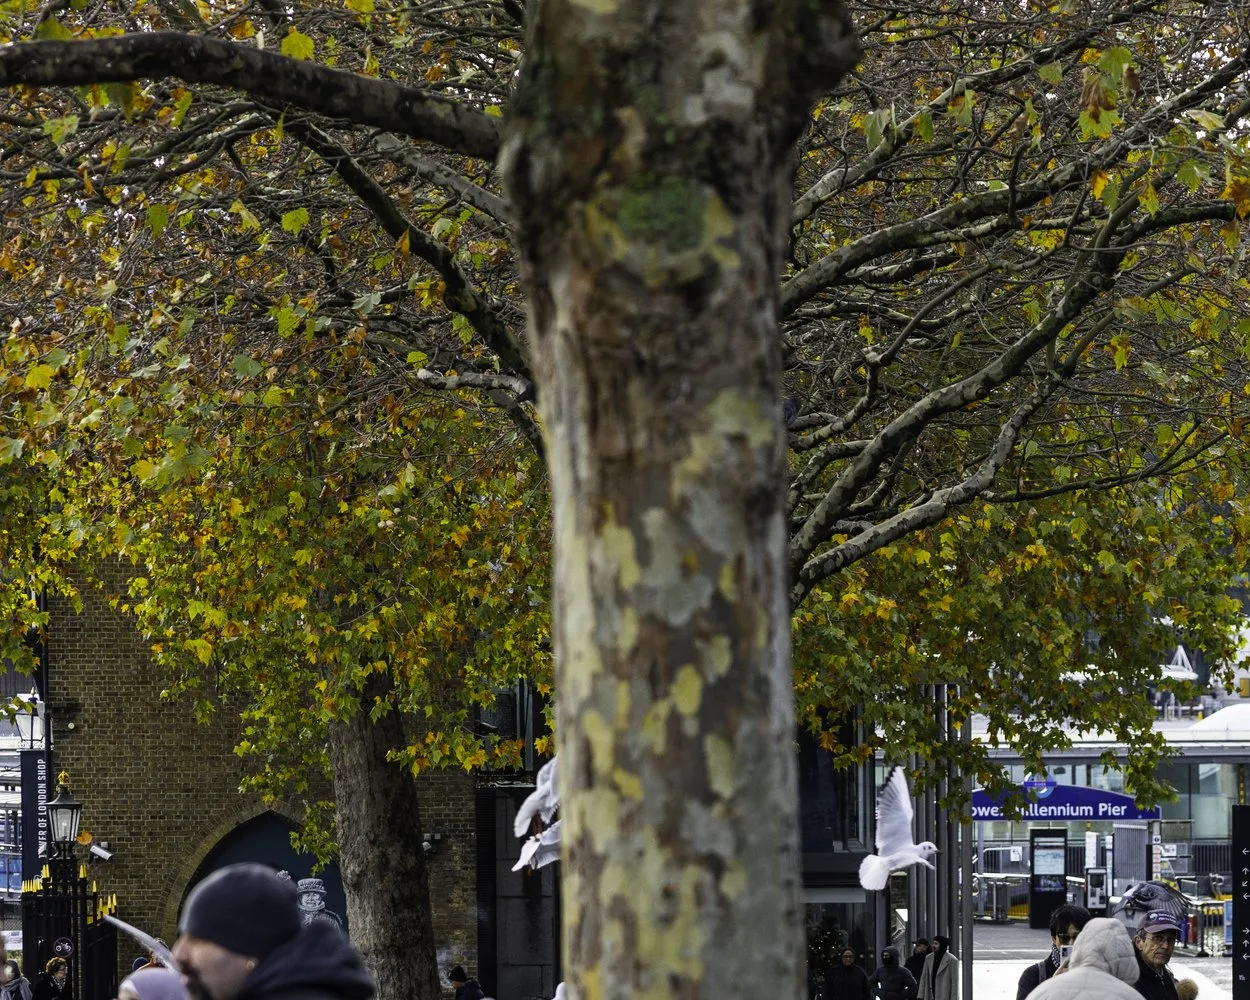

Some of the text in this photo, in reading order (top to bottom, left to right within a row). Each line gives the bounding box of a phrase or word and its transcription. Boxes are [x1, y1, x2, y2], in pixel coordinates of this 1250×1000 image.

[37, 759, 46, 780] SHOP
[38, 783, 47, 815] LONDON
[1099, 802, 1127, 816] Pier
[38, 818, 47, 829] OF
